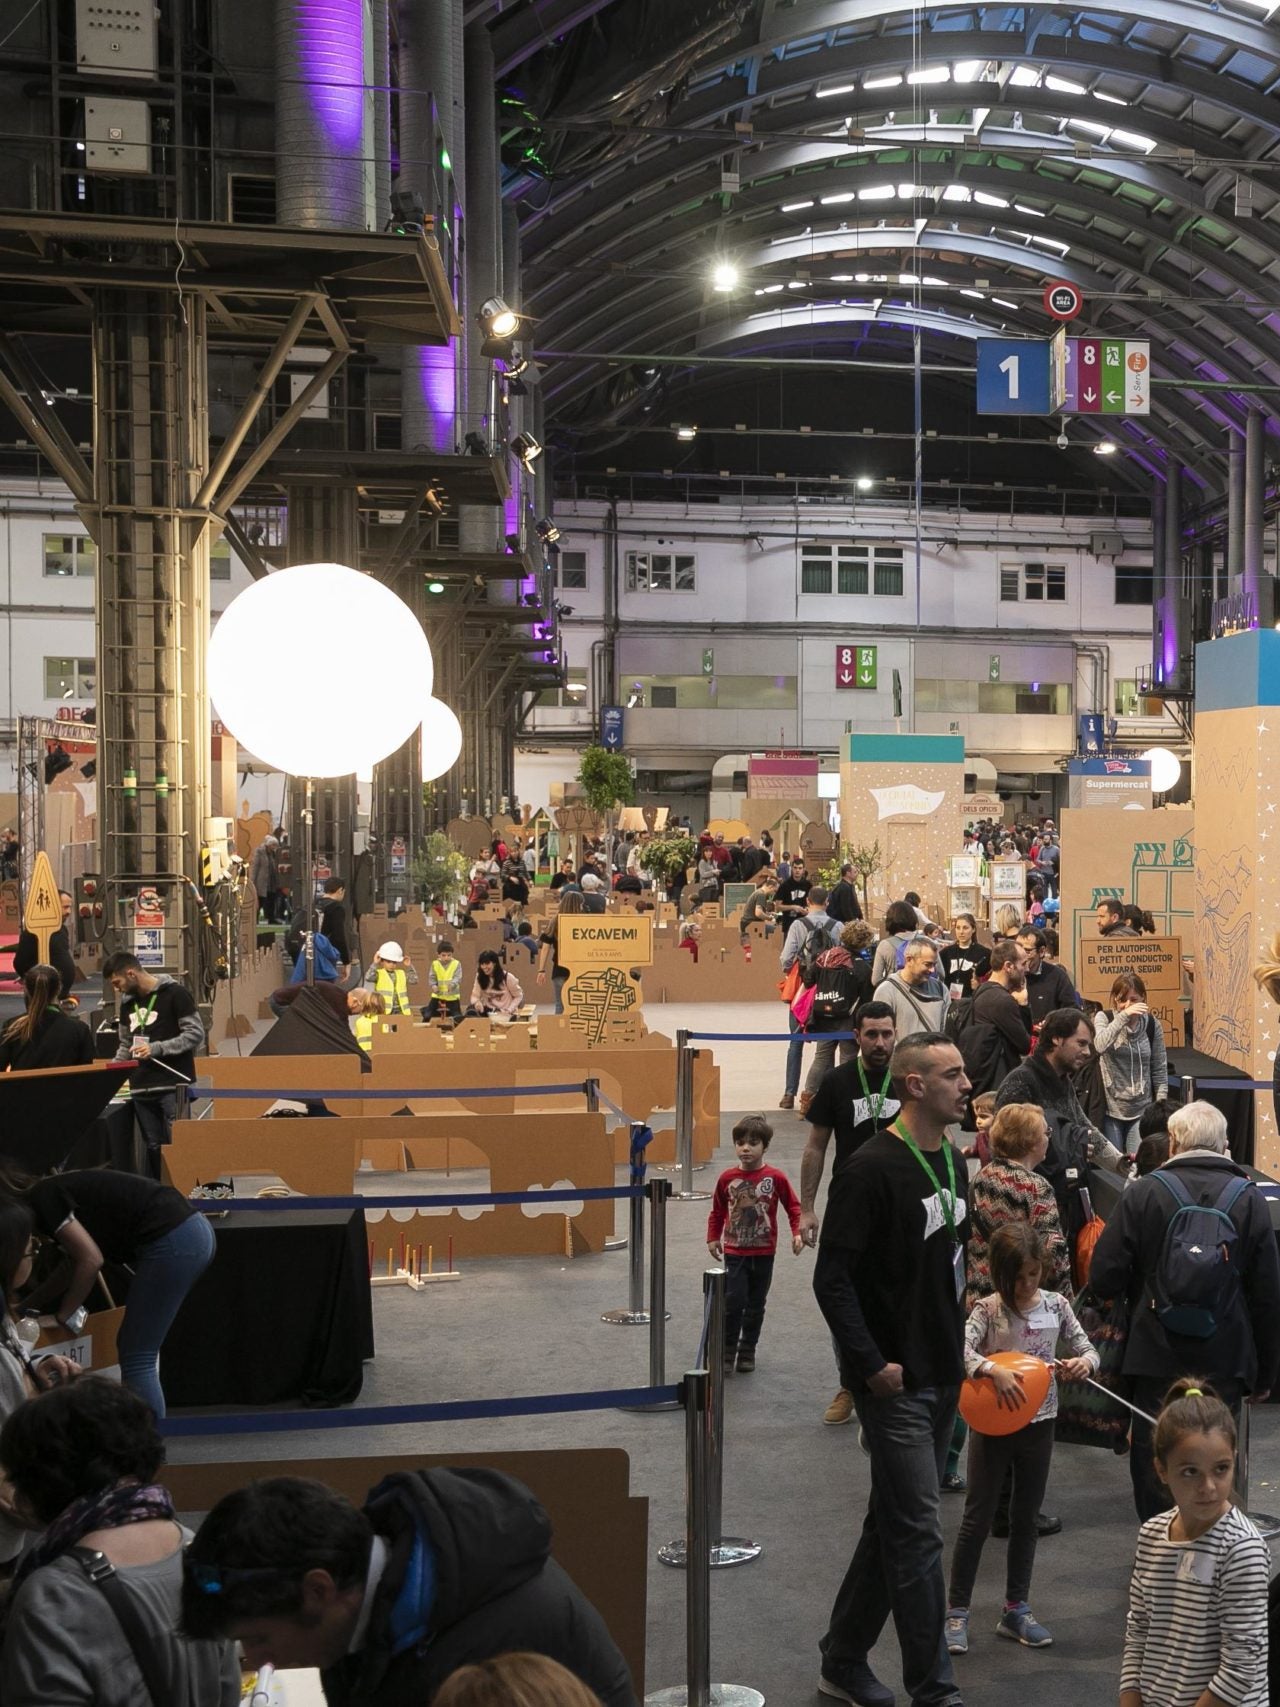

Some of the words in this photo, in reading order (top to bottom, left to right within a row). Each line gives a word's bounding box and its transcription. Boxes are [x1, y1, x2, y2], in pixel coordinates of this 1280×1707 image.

[1084, 345, 1096, 365] 8
[999, 355, 1019, 399] 1
[841, 648, 852, 665] 8
[1086, 780, 1149, 789] Supermercat
[572, 928, 638, 940] EXCAVEM!
[1097, 945, 1113, 953] PER
[1087, 956, 1097, 964] EL
[1099, 955, 1123, 964] PETIT
[1125, 954, 1173, 963] CONDUCTOR
[1137, 965, 1162, 973] SEGUR
[760, 1177, 773, 1194] 3
